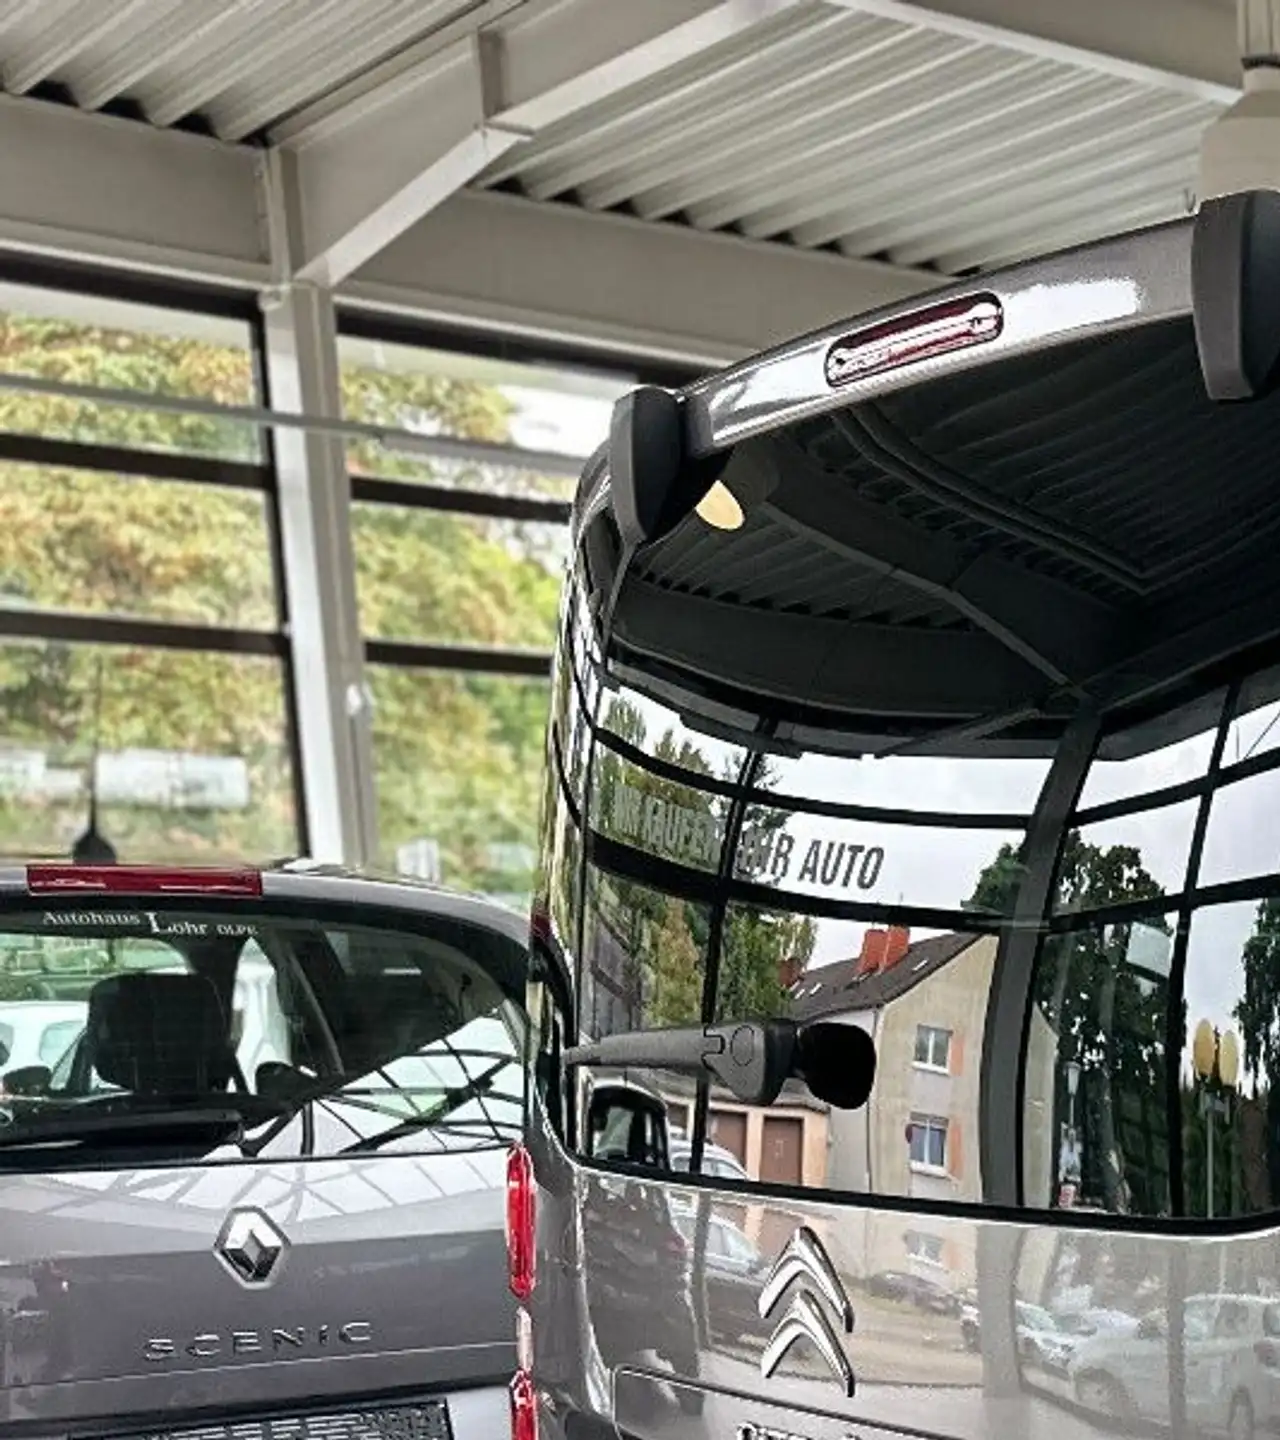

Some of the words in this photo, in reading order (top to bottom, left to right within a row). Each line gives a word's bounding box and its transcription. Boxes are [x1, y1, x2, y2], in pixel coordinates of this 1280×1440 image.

[797, 837, 885, 890] AUTO
[43, 911, 140, 926] Autohaus
[145, 911, 208, 935] Lohr
[144, 1321, 372, 1362] SCENIC
